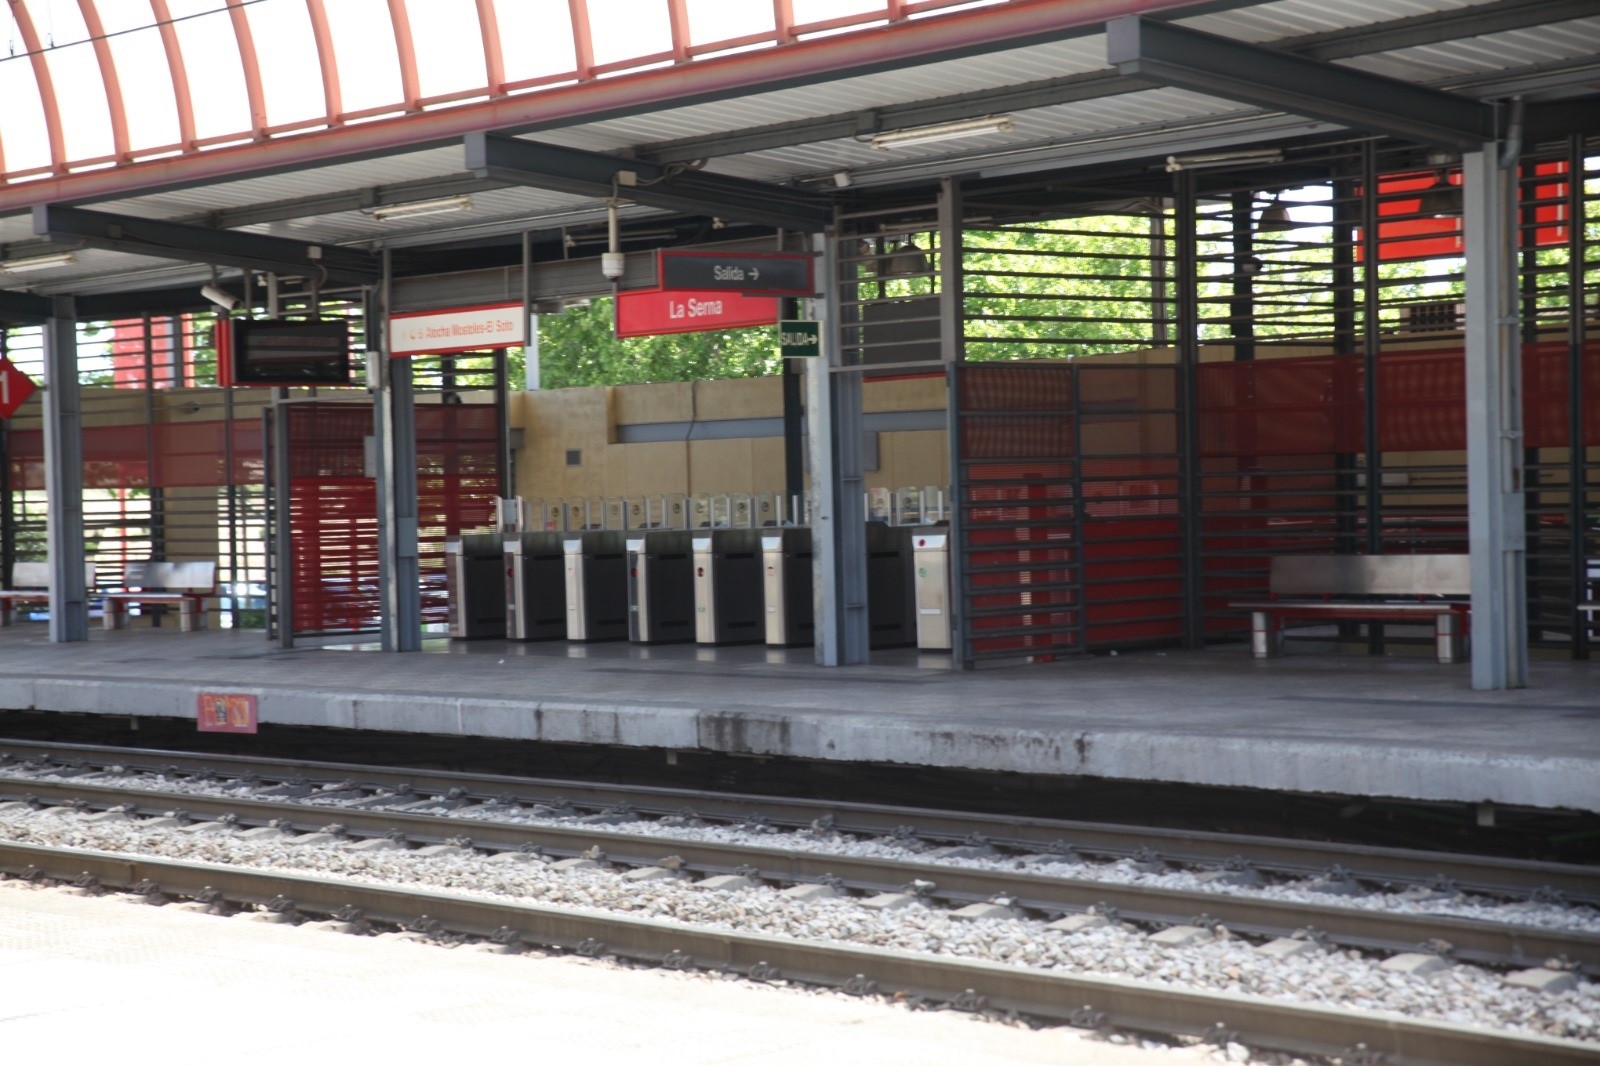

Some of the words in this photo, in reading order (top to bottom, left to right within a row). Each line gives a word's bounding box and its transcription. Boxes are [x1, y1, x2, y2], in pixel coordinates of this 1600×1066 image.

[713, 265, 744, 281] Salida
[669, 301, 685, 319] La
[781, 332, 809, 346] SALIDA
[0, 370, 10, 405] 1
